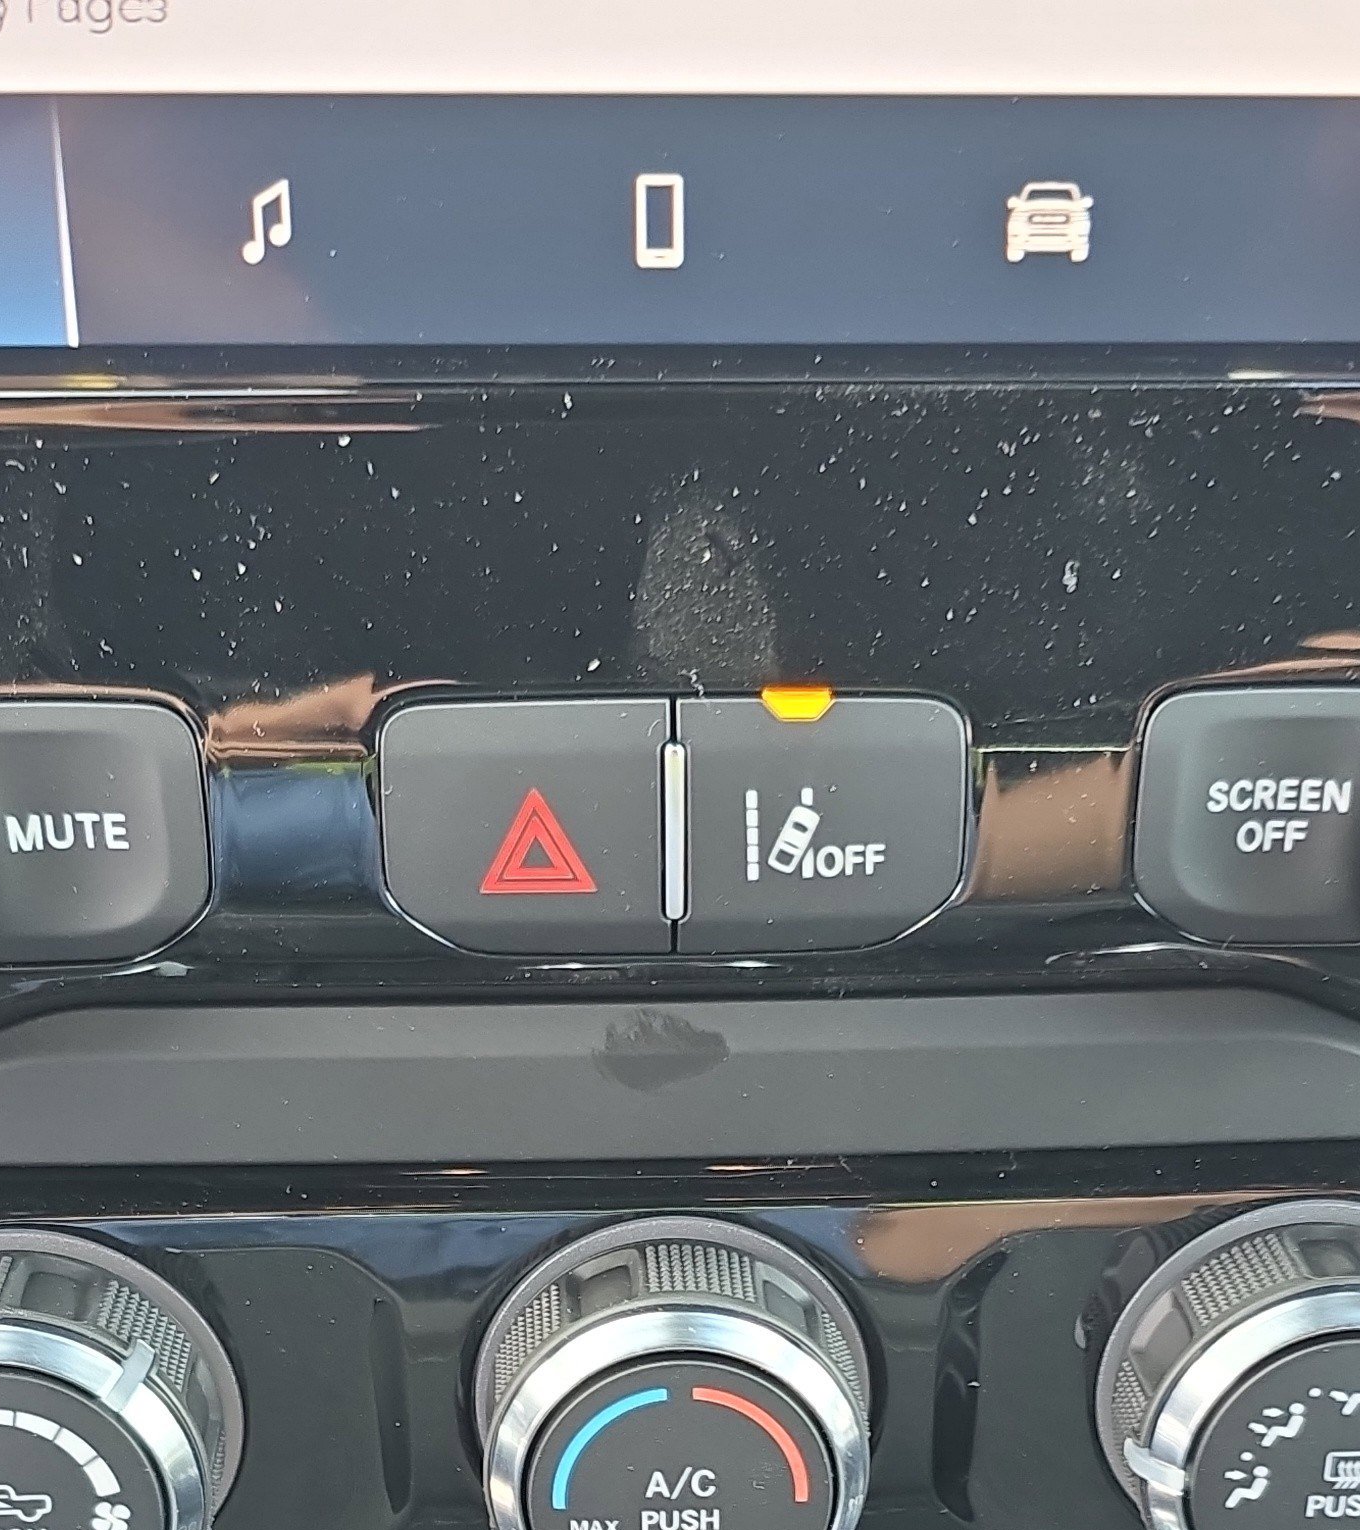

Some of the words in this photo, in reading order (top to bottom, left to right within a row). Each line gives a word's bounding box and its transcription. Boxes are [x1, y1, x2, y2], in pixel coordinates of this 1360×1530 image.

[1206, 778, 1352, 814] SCREEN
[5, 812, 131, 853] MUTE
[1235, 820, 1308, 853] OFF
[815, 843, 887, 879] OFF
[645, 1467, 717, 1501] A/C
